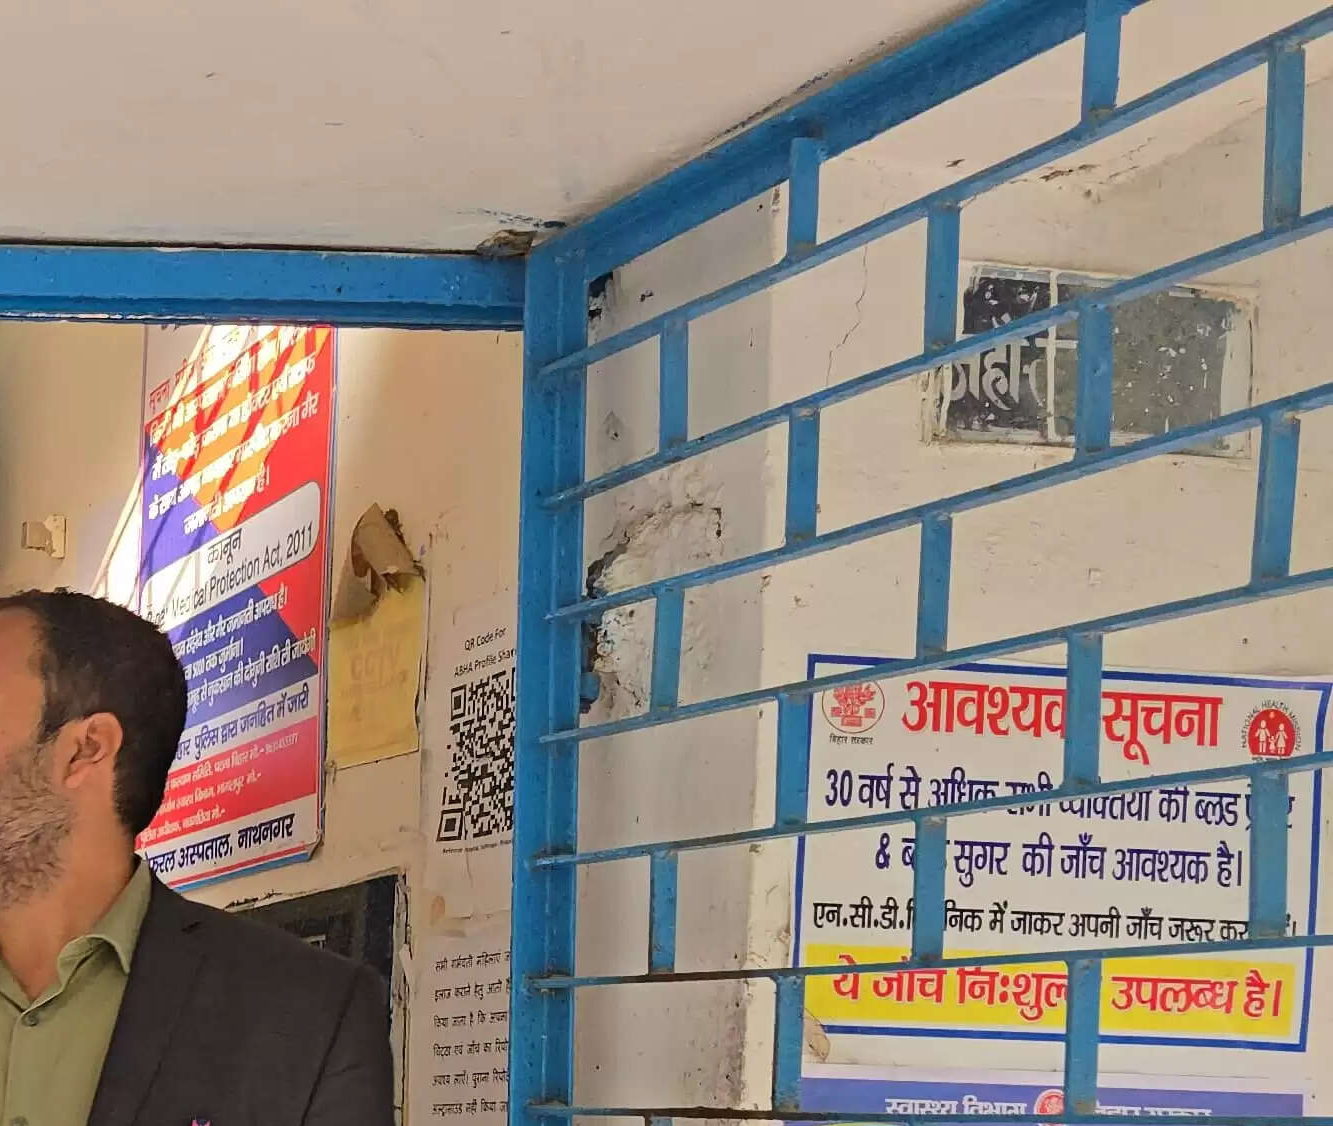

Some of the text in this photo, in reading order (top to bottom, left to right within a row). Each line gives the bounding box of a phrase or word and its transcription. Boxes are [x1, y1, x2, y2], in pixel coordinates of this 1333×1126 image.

[207, 528, 243, 565] कानून
[210, 556, 265, 602] Protection
[262, 543, 283, 573] Act,
[286, 525, 313, 560] 2011
[476, 631, 494, 647] Code
[194, 724, 220, 762] पुलिस
[287, 681, 311, 714] जारी
[829, 733, 874, 746] बिहार सरकार
[1101, 690, 1224, 766] सूचना
[825, 768, 854, 808] 30
[858, 762, 895, 810] वर्ष
[898, 765, 923, 811] से
[927, 766, 999, 808] अधिक
[1195, 790, 1241, 827] ब्लड
[177, 833, 234, 870] अस्पताल,
[237, 812, 296, 851] नाथनगर
[875, 832, 891, 870] &
[953, 840, 1012, 888] सुगर
[1021, 832, 1055, 878] की
[1060, 831, 1108, 880] जाँच
[1112, 847, 1212, 885] आवश्यक
[1216, 840, 1243, 888] है।
[989, 900, 1009, 934] में
[1010, 909, 1066, 938] जाकर
[1069, 906, 1122, 940] अपनी
[1126, 906, 1164, 941] जाँच
[1169, 916, 1217, 943] जरूर
[832, 954, 860, 1001] ये
[1110, 975, 1239, 1015] उपलब्ध
[1242, 968, 1283, 1018] है।
